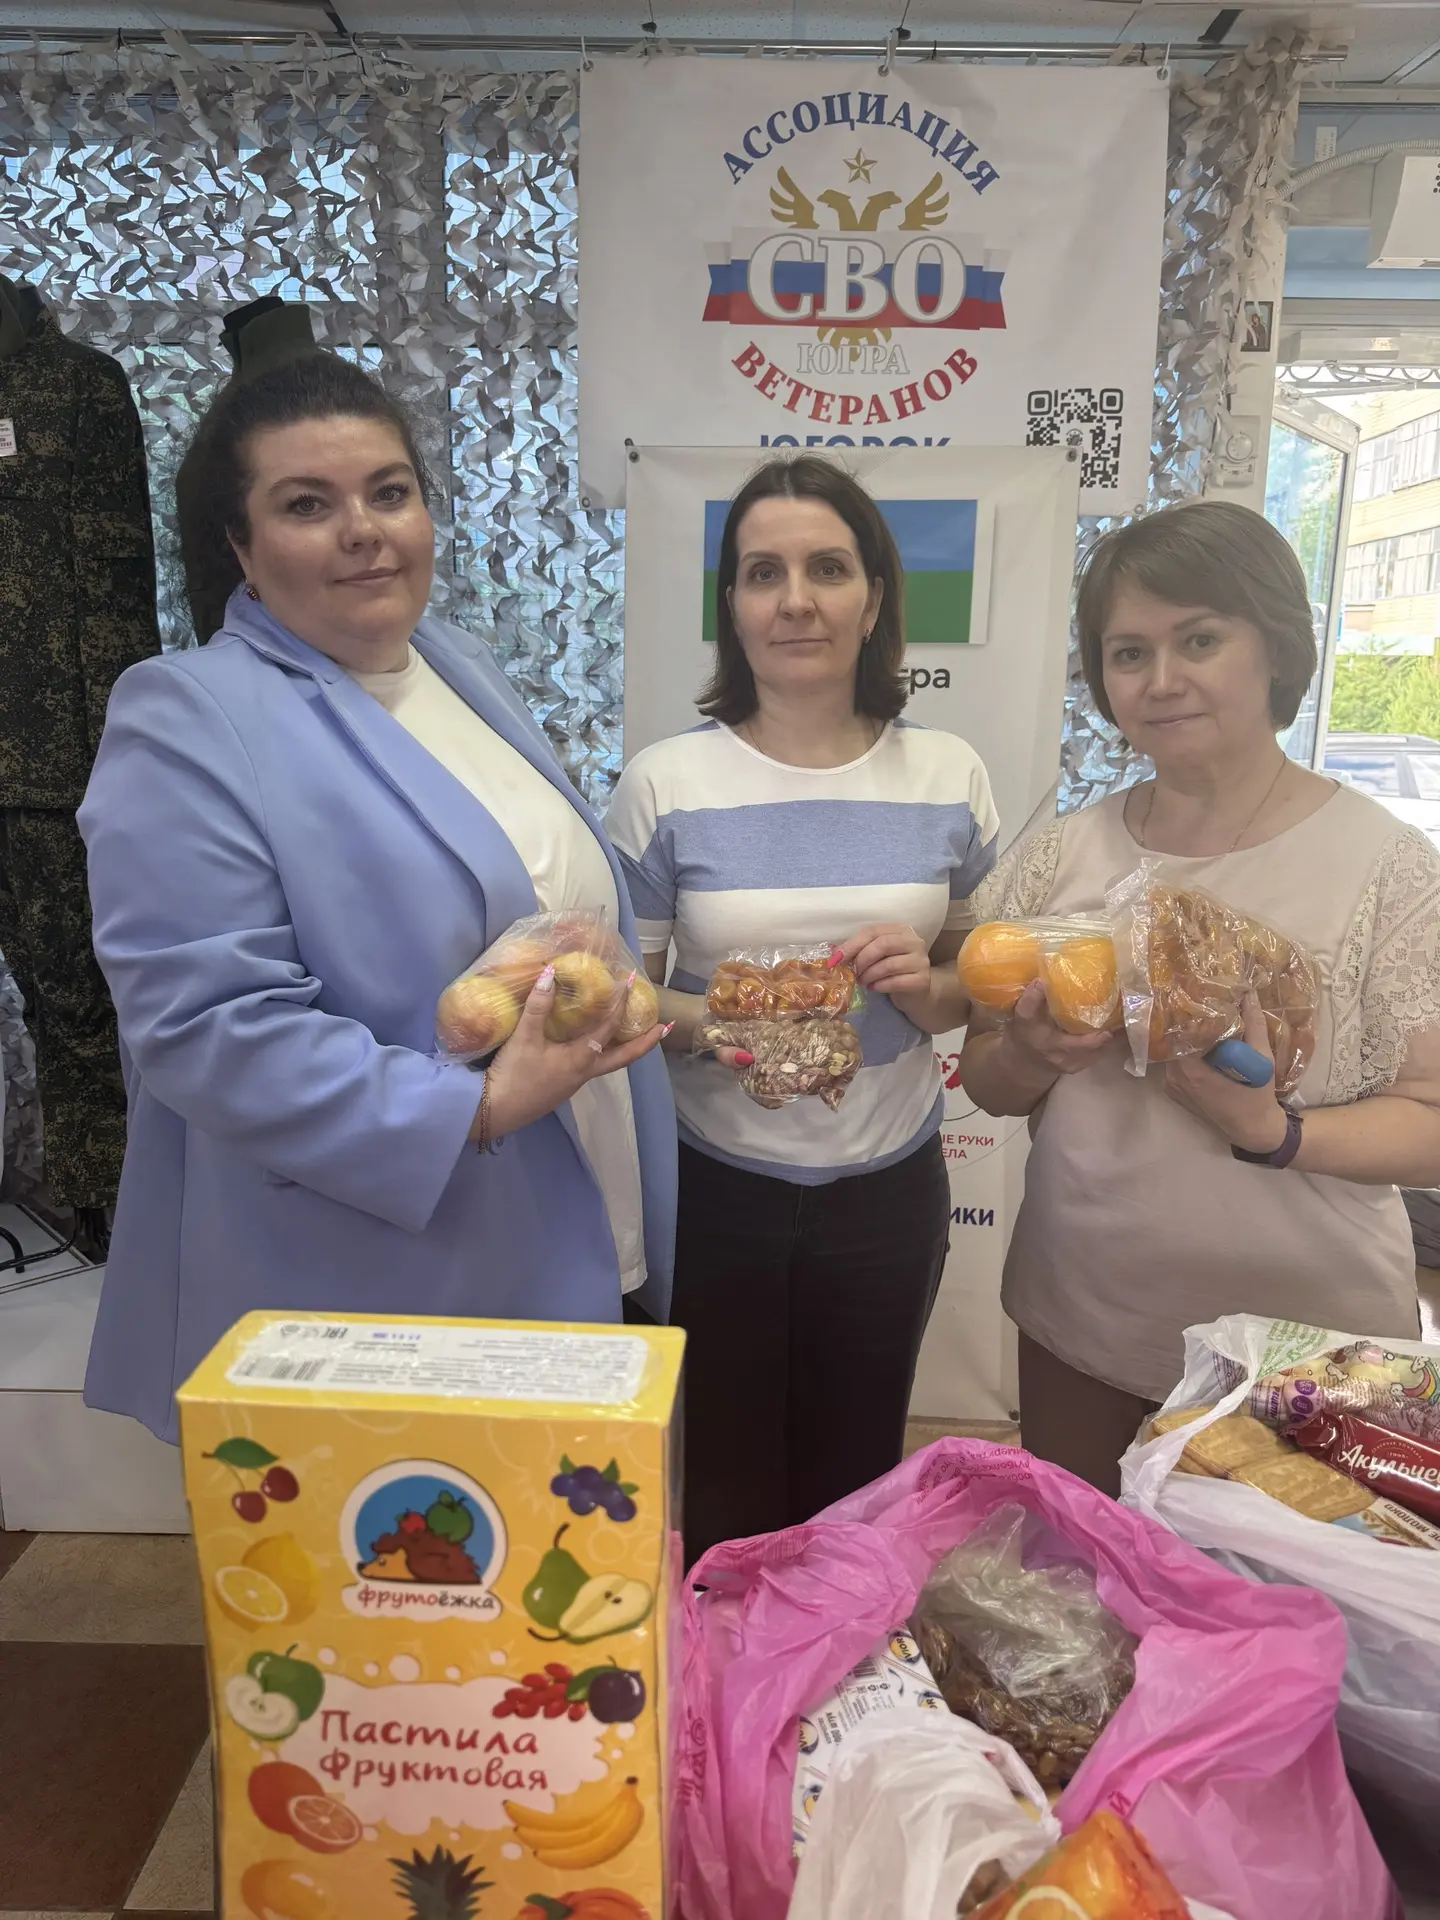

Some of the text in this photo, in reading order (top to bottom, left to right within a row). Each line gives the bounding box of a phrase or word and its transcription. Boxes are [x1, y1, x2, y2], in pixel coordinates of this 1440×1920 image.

[721, 91, 1000, 196] АССОЦИАЦИЯ
[746, 233, 967, 324] СВО
[797, 343, 910, 375] ЮГРА
[731, 341, 979, 426] ВЕТЕРАНОВ
[958, 1135, 994, 1147] РУКИ
[1337, 1444, 1440, 1486] Акульче
[1383, 1503, 1428, 1535] МОЛОКО
[319, 1710, 538, 1755] Пастила
